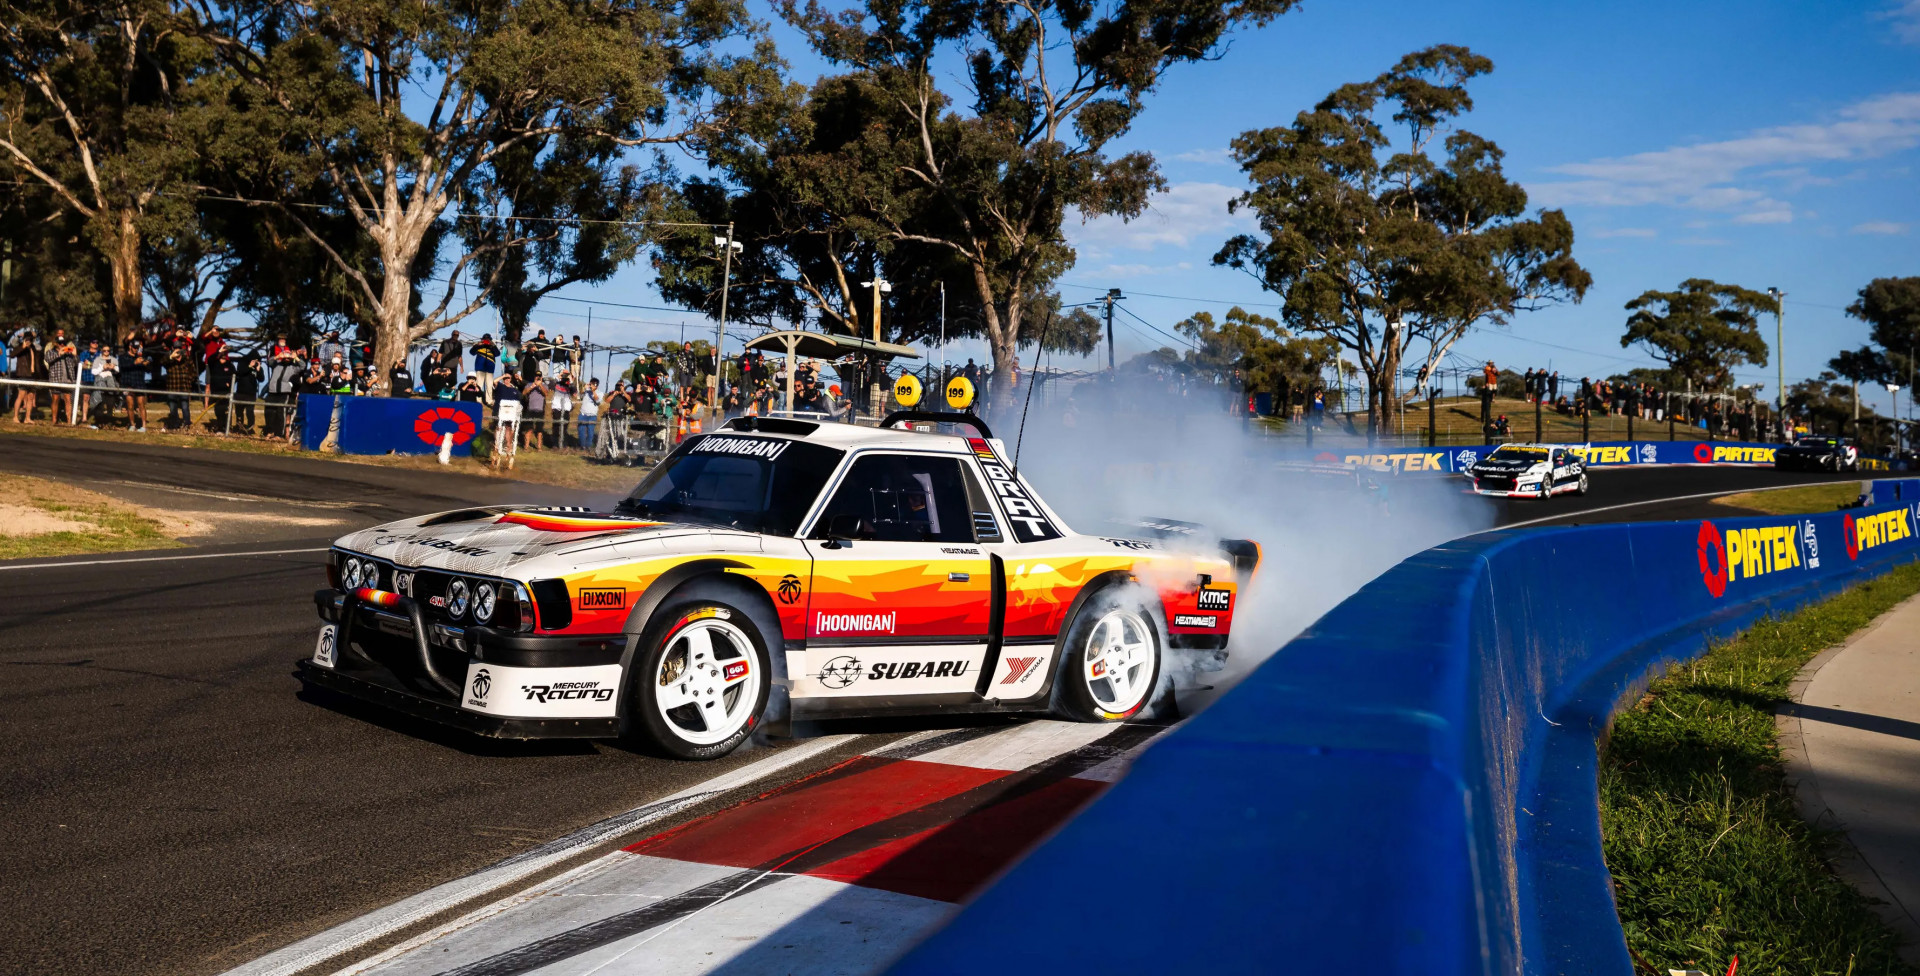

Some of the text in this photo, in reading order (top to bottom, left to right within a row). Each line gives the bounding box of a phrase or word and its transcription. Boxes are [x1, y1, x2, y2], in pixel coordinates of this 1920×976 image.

[896, 385, 913, 396] 199
[948, 387, 965, 398] 199
[1713, 446, 1777, 463] PIRTEK
[983, 464, 1046, 537] BRAT
[1804, 520, 1818, 557] 45
[1856, 508, 1911, 552] PIRTEK
[1726, 525, 1800, 582] PIRTEK
[429, 595, 447, 608] 4W
[583, 591, 622, 606] DIXXON
[1199, 591, 1229, 604] KMC
[816, 611, 896, 635] [HOONIGAN]
[868, 660, 970, 681] SUBARU
[1020, 656, 1044, 683] YOKOHAMA
[526, 685, 614, 703] Racing
[552, 681, 600, 690] MERCURY
